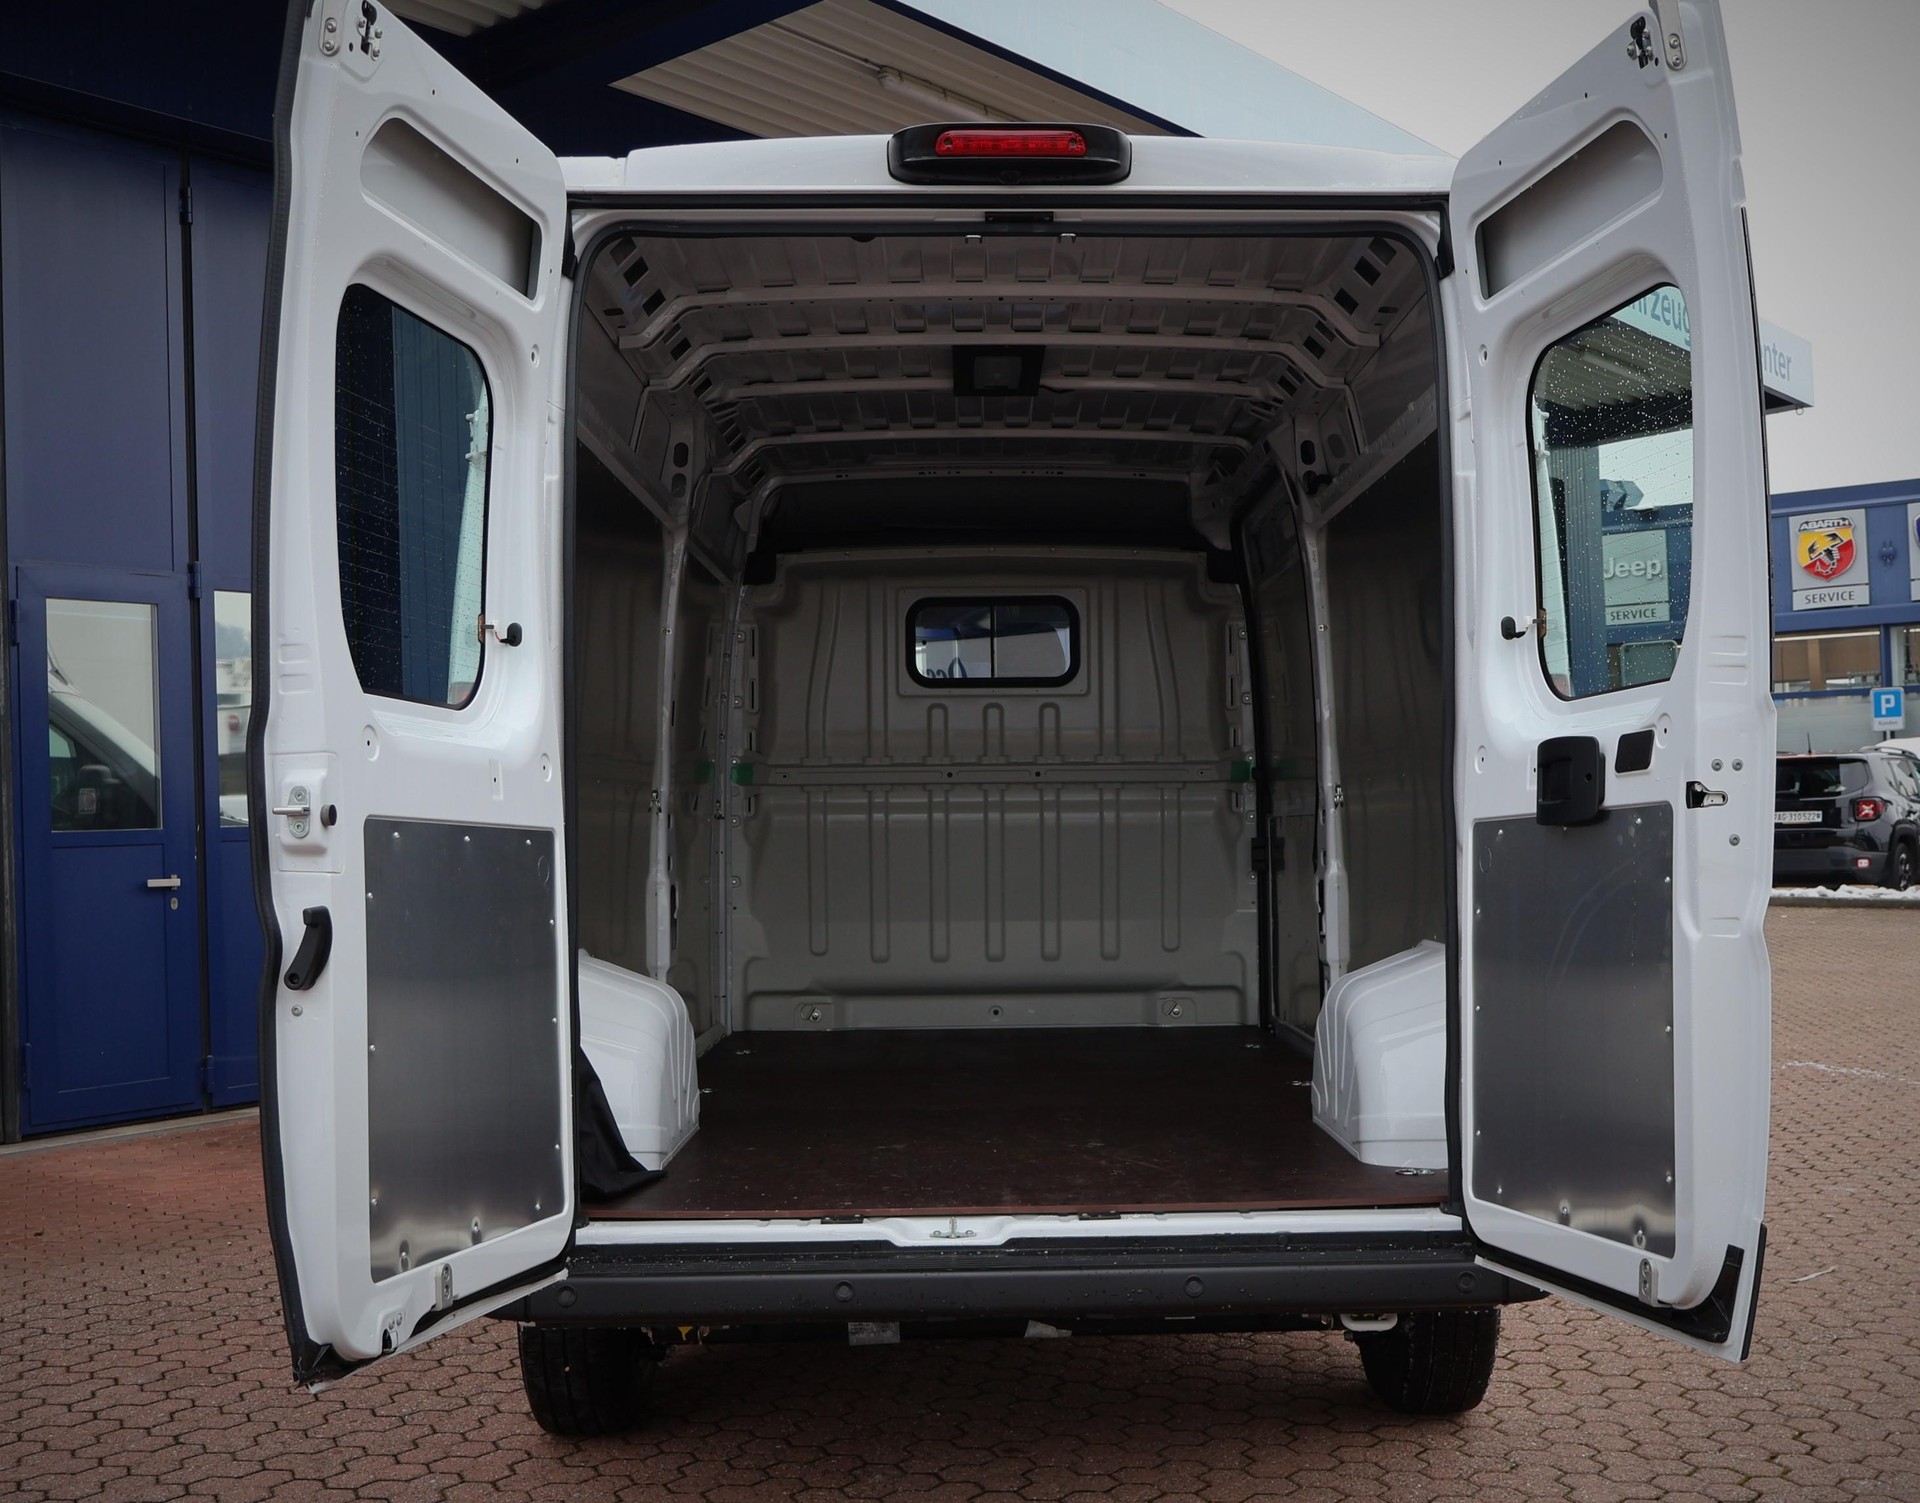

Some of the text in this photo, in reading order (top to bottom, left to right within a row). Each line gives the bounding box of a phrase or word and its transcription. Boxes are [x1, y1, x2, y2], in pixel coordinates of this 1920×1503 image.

[1762, 342, 1792, 381] nter
[1800, 519, 1850, 530] ABARTH
[1603, 557, 1662, 579] Jeep
[1804, 590, 1855, 605] SERVICE
[1610, 607, 1657, 621] SERVICE
[1881, 694, 1896, 716] P
